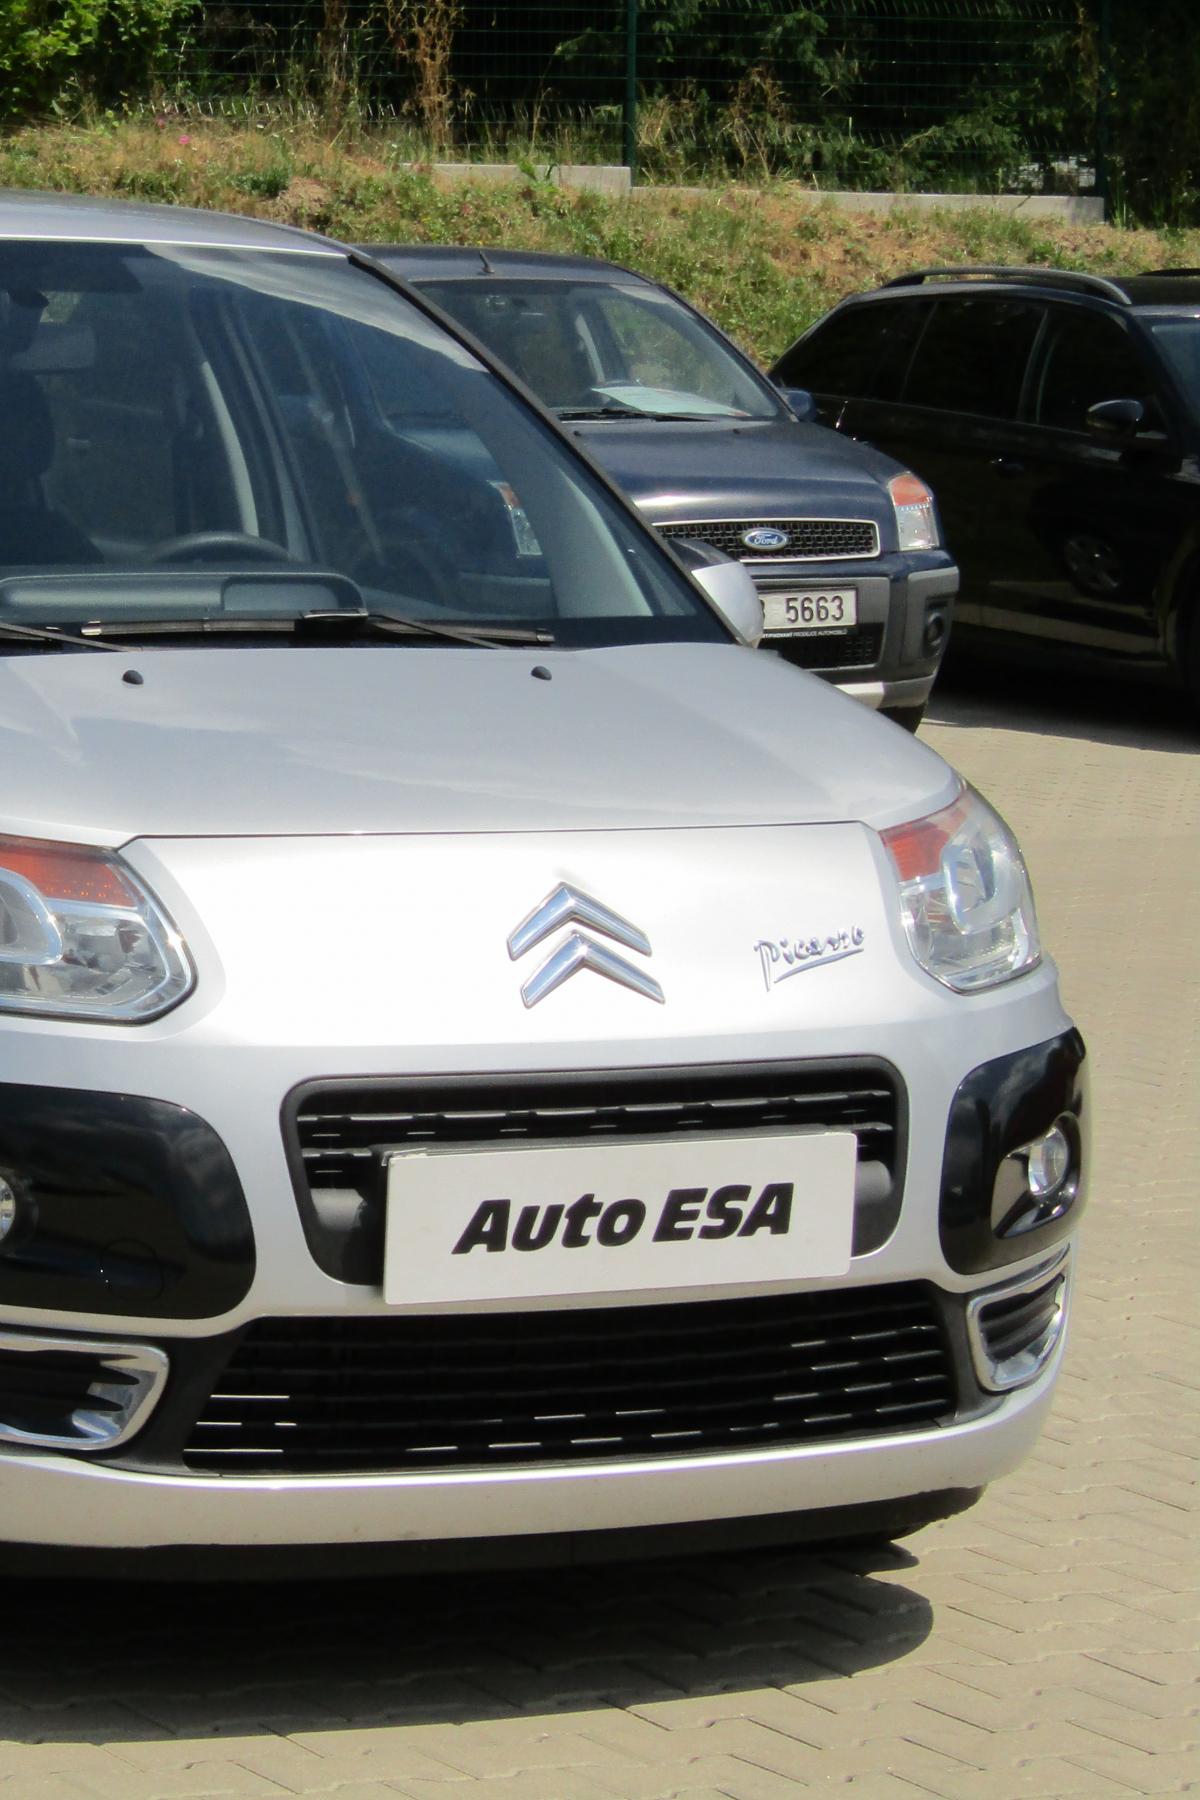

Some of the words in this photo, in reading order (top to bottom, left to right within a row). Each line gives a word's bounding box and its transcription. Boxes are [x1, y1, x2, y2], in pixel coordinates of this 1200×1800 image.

[785, 595, 844, 623] 5663
[753, 925, 865, 993] Picasso
[451, 1193, 647, 1254] Auto
[651, 1182, 794, 1242] ESA
